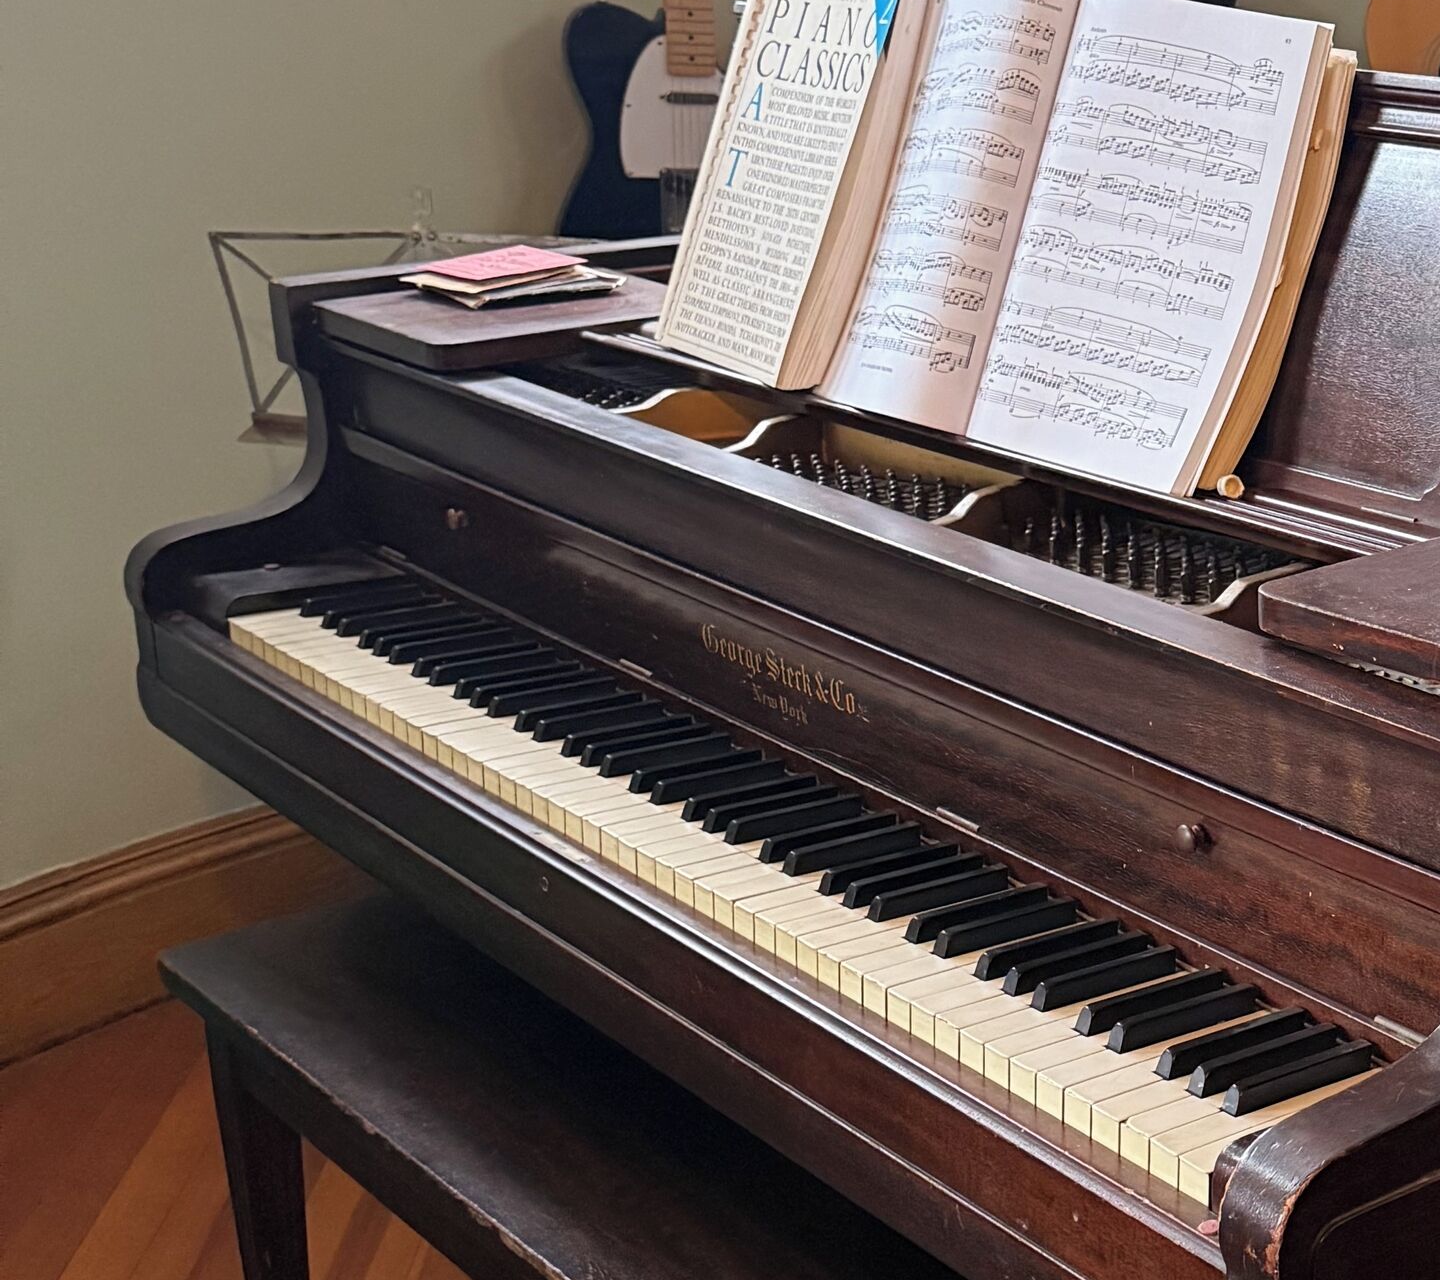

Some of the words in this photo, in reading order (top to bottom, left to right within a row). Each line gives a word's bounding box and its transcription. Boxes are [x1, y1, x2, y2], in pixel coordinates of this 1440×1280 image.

[757, 40, 871, 93] CLASSICS
[741, 82, 764, 122] A
[702, 624, 762, 678] George
